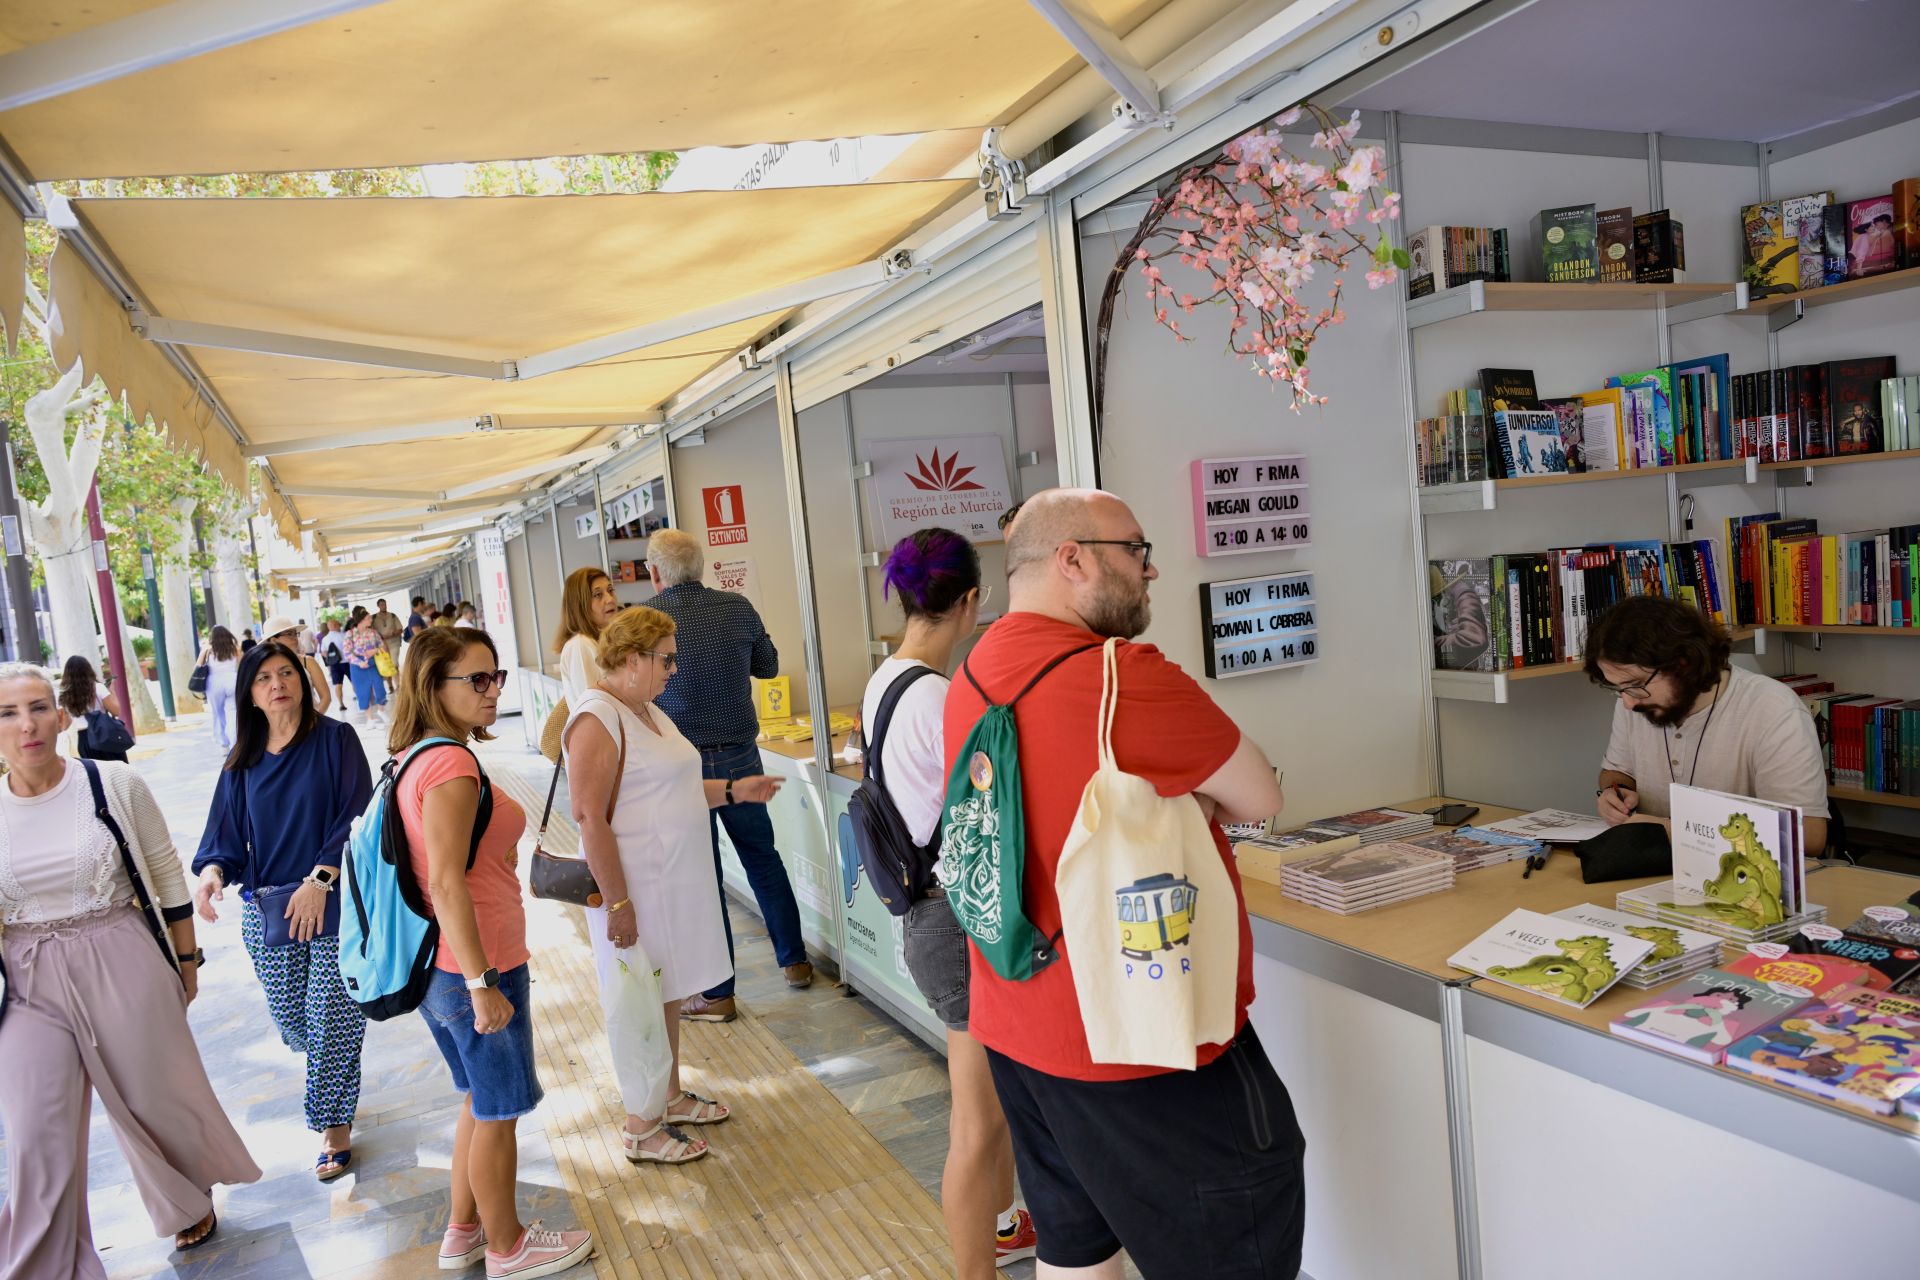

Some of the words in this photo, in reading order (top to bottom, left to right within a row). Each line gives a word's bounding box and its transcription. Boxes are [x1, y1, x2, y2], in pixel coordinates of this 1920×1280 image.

[829, 142, 840, 167] 10
[1549, 268, 1596, 282] SANDERSON
[1553, 259, 1590, 272] BRANDON
[1214, 467, 1239, 484] HOY
[892, 504, 938, 522] Región
[942, 503, 956, 514] de
[960, 500, 1004, 514] Murcia
[1207, 498, 1250, 516] MEGAN
[1258, 495, 1298, 511] GOULD
[709, 528, 746, 545] EXTINTOR
[1214, 530, 1248, 547] 12:00
[1256, 528, 1265, 542] A
[720, 578, 745, 589] 30€
[1225, 588, 1251, 606] HOY
[1267, 582, 1310, 599] FIRMA
[1212, 620, 1252, 639] ROMAN
[1257, 618, 1264, 632] L
[1270, 611, 1313, 630] CABRERA
[1221, 650, 1256, 669] 11:00
[1263, 648, 1272, 662] A
[1281, 641, 1315, 659] 14:00
[1685, 820, 1691, 832] A
[1692, 822, 1715, 839] VECES
[1586, 916, 1618, 928] VECES
[1505, 929, 1515, 937] A
[1516, 931, 1549, 946] VECES
[1822, 939, 1890, 961] MIEDO
